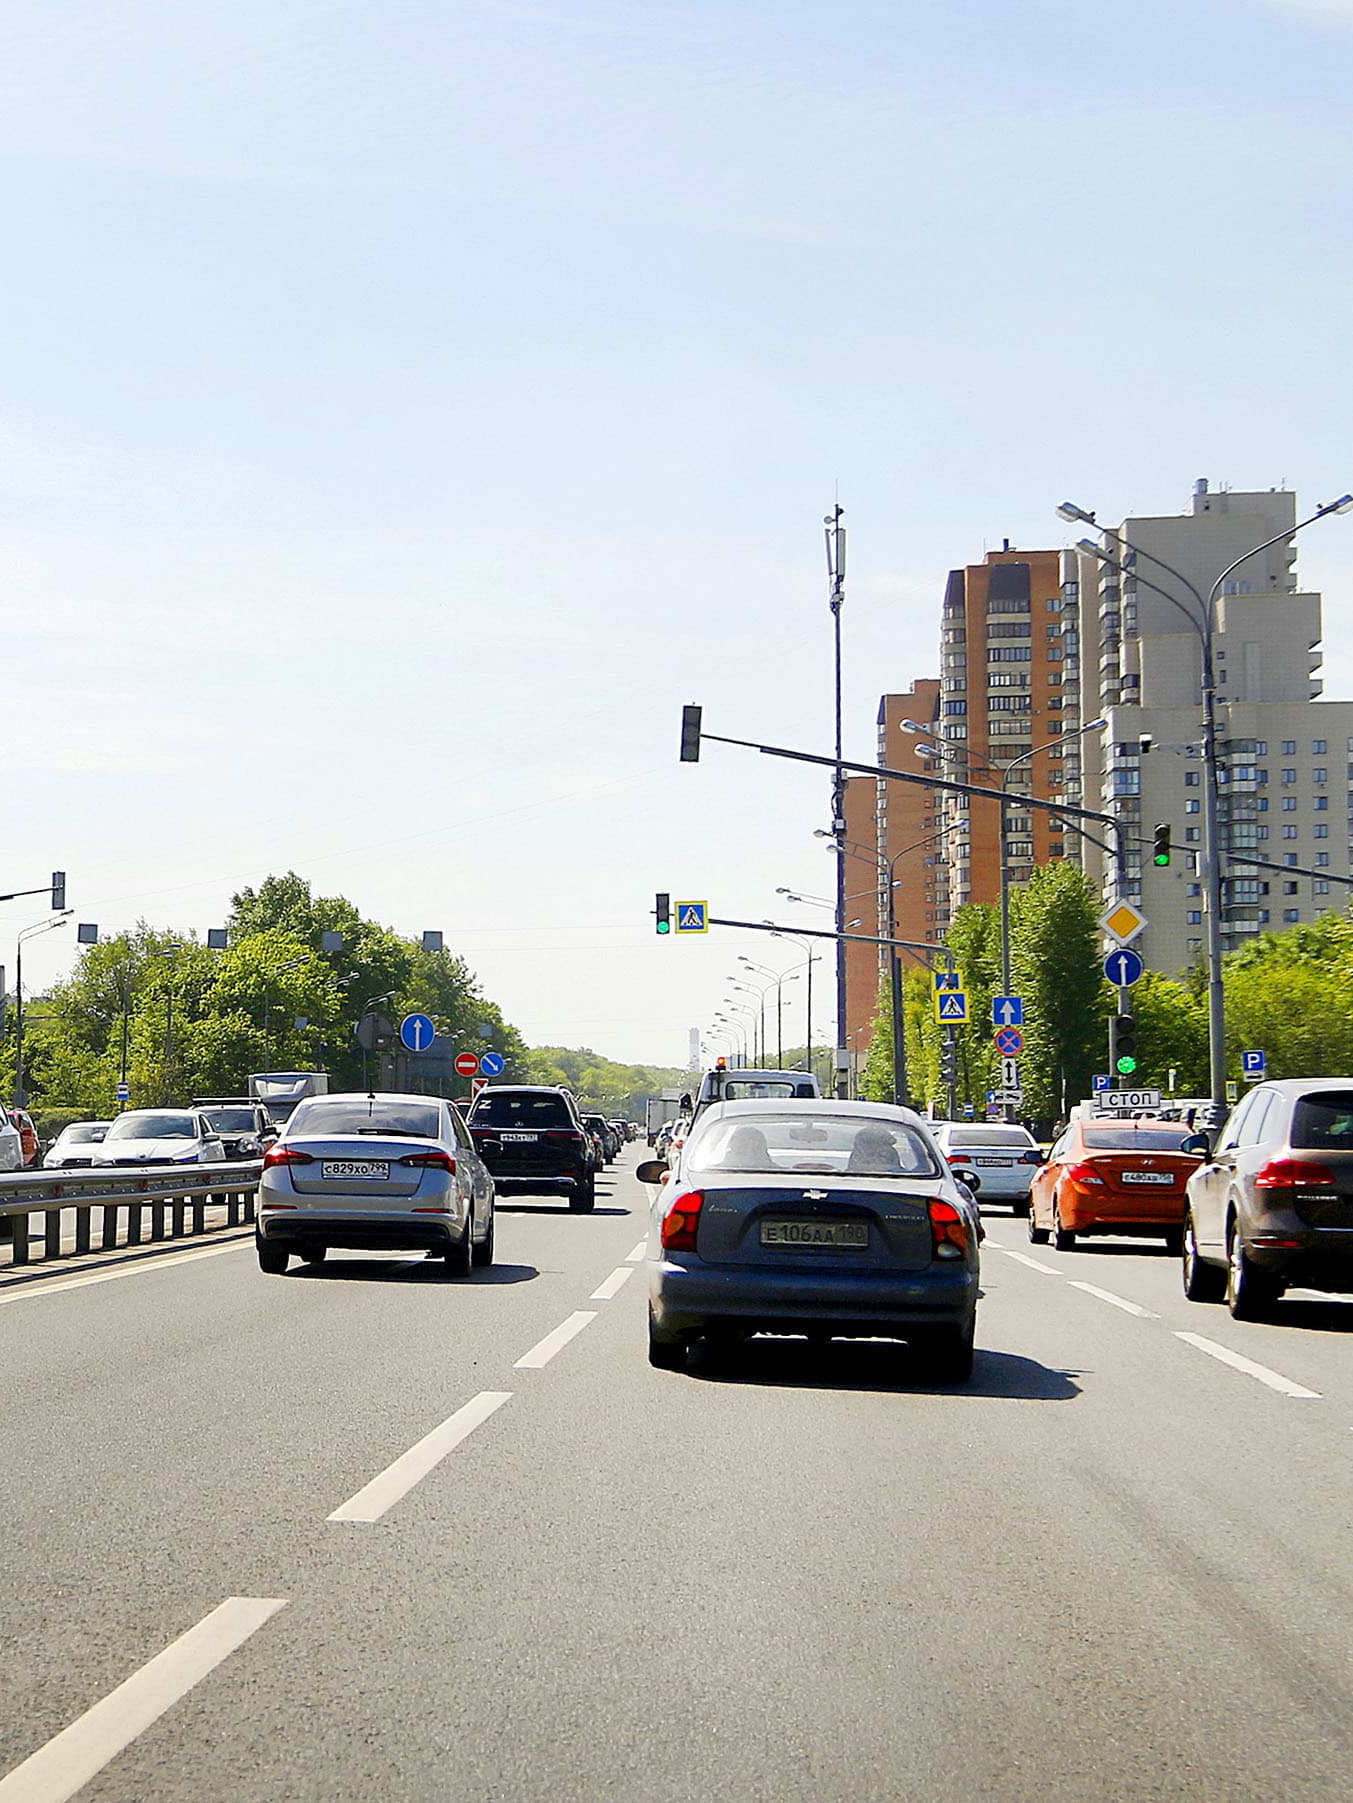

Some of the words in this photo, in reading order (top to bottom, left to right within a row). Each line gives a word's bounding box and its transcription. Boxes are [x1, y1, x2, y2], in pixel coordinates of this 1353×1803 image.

[1248, 1053, 1260, 1069] P
[1096, 1076, 1107, 1089] P
[1109, 1093, 1152, 1106] СТОП
